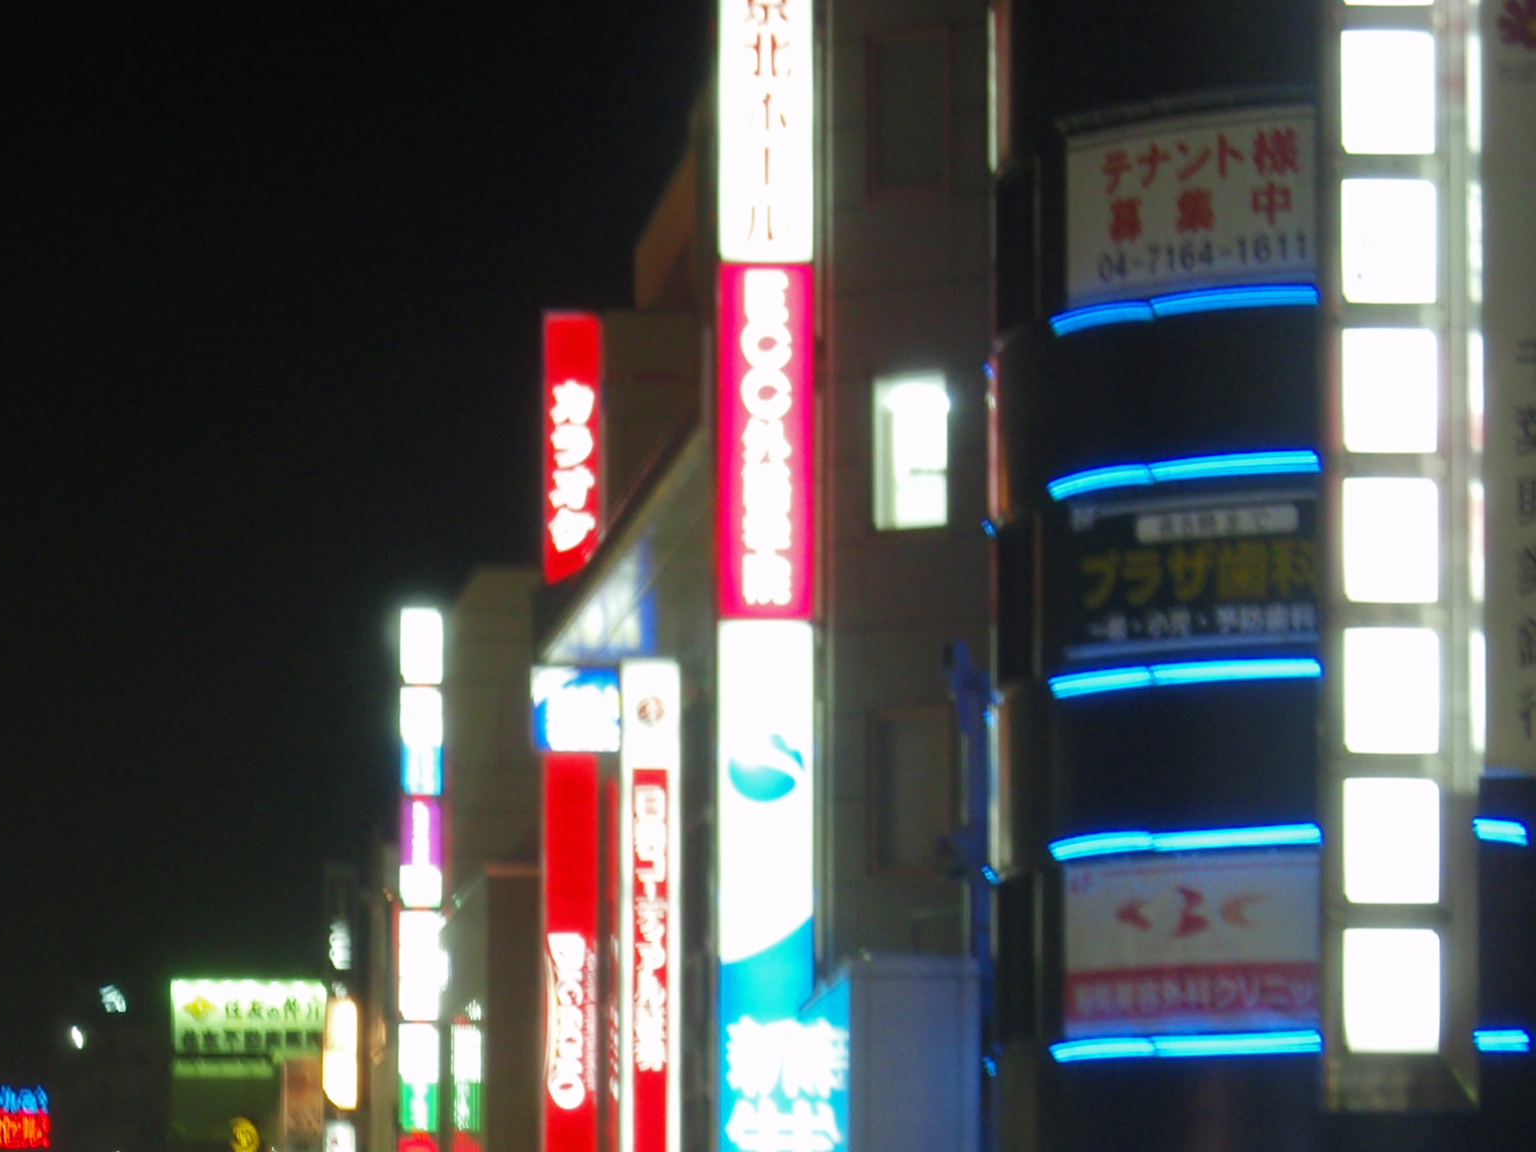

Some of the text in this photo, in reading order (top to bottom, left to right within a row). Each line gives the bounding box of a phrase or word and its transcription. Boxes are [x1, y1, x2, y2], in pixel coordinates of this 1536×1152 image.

[1101, 126, 1300, 195] テナント様
[1109, 181, 1292, 243] 募集中
[1097, 231, 1307, 284] 04-7164-1611
